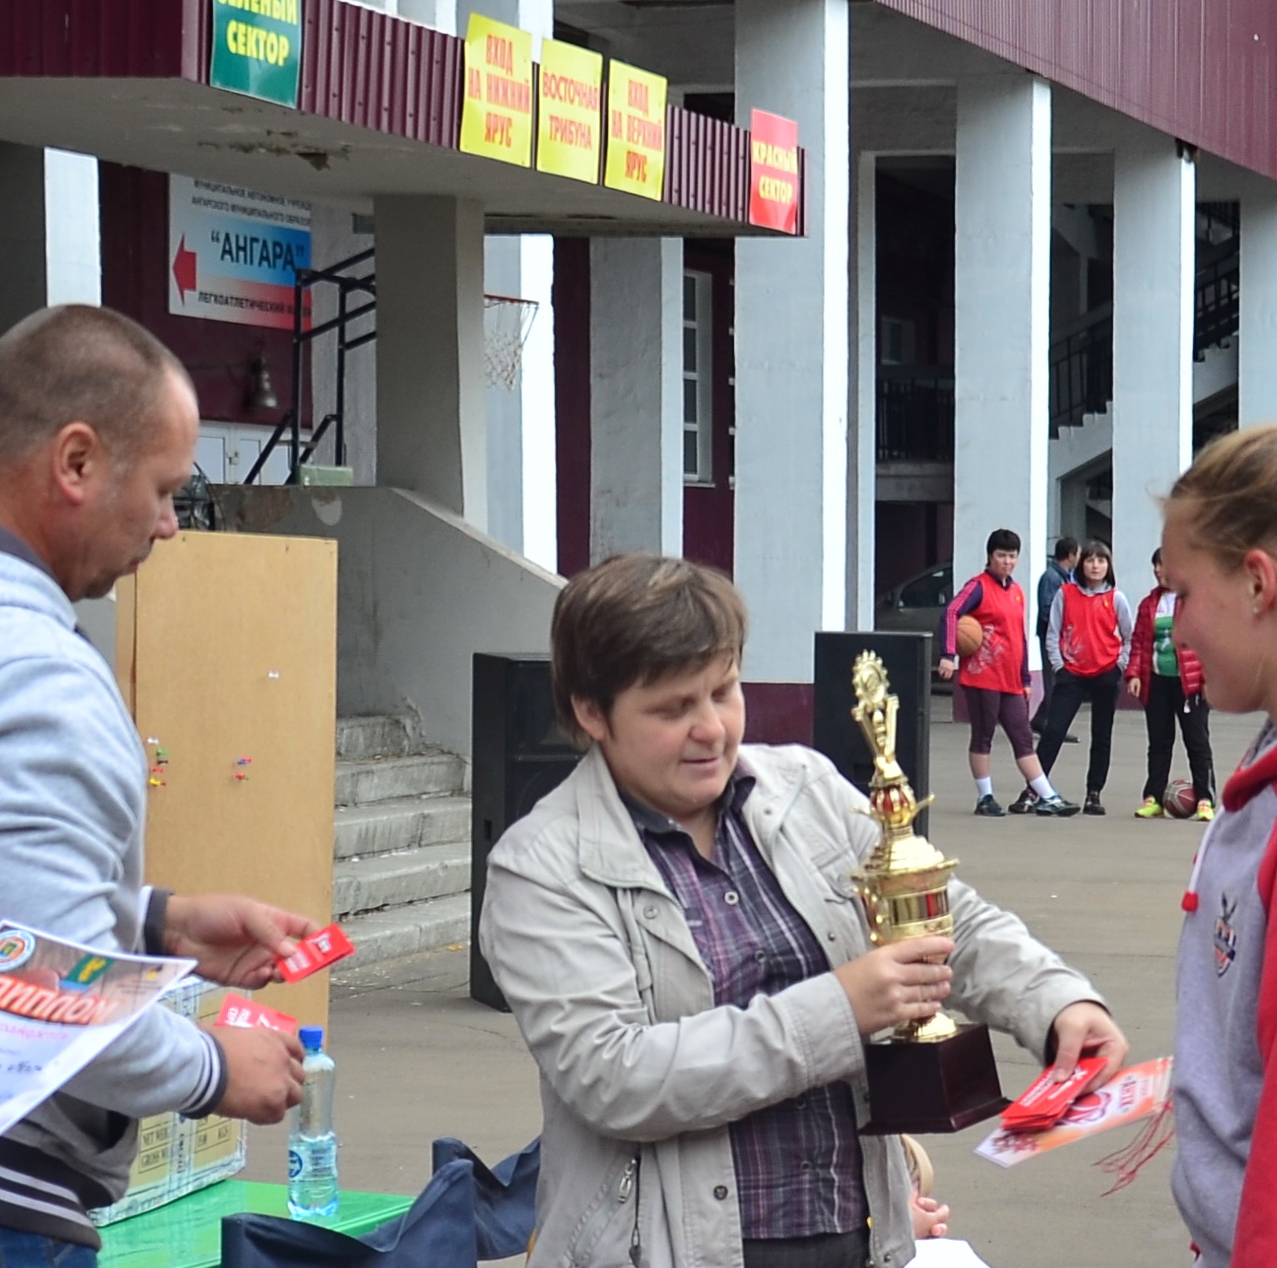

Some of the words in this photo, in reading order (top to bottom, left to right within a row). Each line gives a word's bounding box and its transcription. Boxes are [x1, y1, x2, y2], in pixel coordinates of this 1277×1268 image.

[227, 19, 290, 67] СЕКТОР
[486, 34, 513, 76] ВХОД
[468, 67, 481, 101] НА
[486, 72, 530, 115] НИЖНИЙ
[542, 71, 599, 112] ВОСТОЧНАЯ
[485, 112, 513, 148] ЯРУС
[549, 114, 592, 150] ТРИБУНА
[625, 150, 648, 183] ЯРУС
[752, 140, 798, 175] КРАСНЫЙ
[759, 175, 793, 205] СЕКТОР
